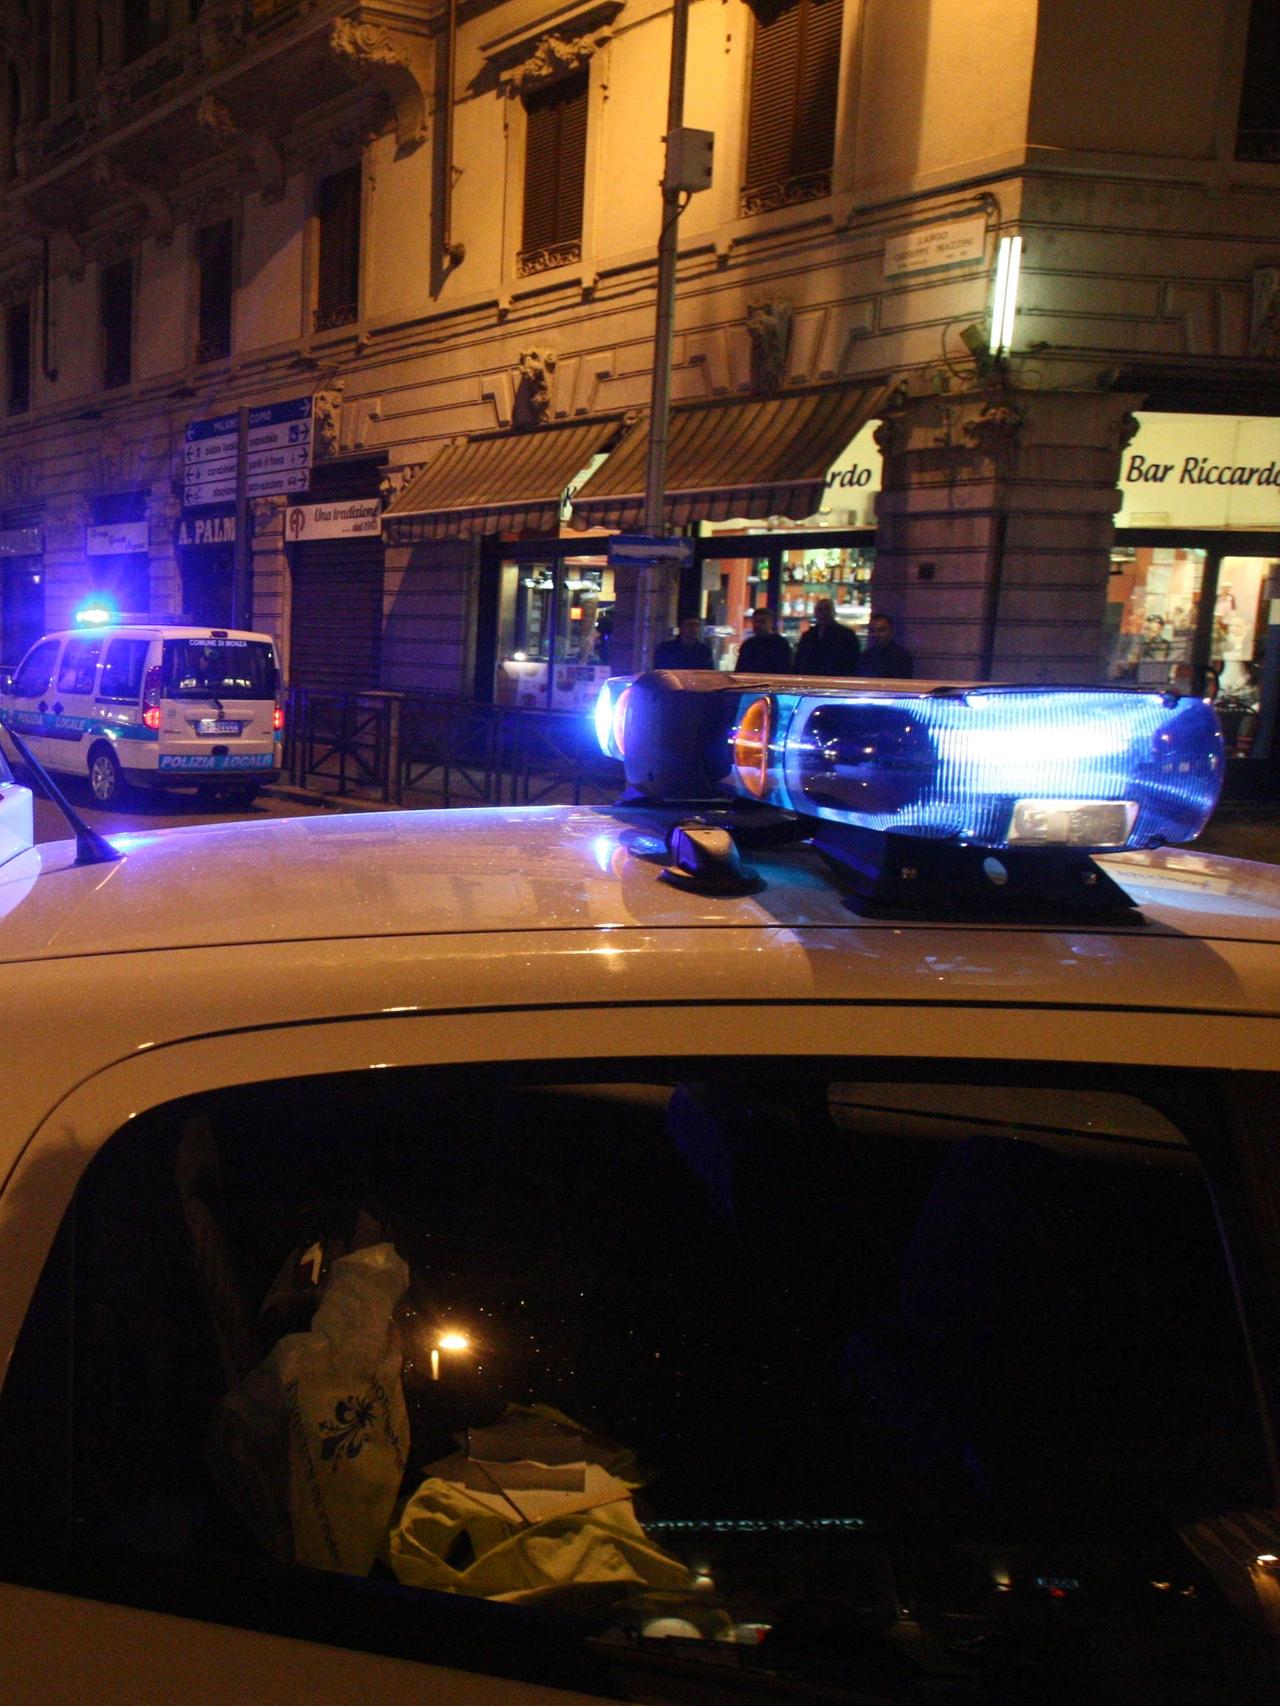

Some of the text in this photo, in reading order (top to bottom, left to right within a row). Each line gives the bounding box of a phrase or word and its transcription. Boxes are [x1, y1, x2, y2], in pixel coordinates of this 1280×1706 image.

[249, 410, 271, 424] COMO
[1126, 455, 1174, 482] Bar
[314, 504, 380, 522] Una tradizione
[178, 521, 192, 545] A.
[189, 639, 217, 647] COMUNE
[226, 640, 248, 648] MONZA
[161, 754, 270, 769] POLIZIA LOCALE
